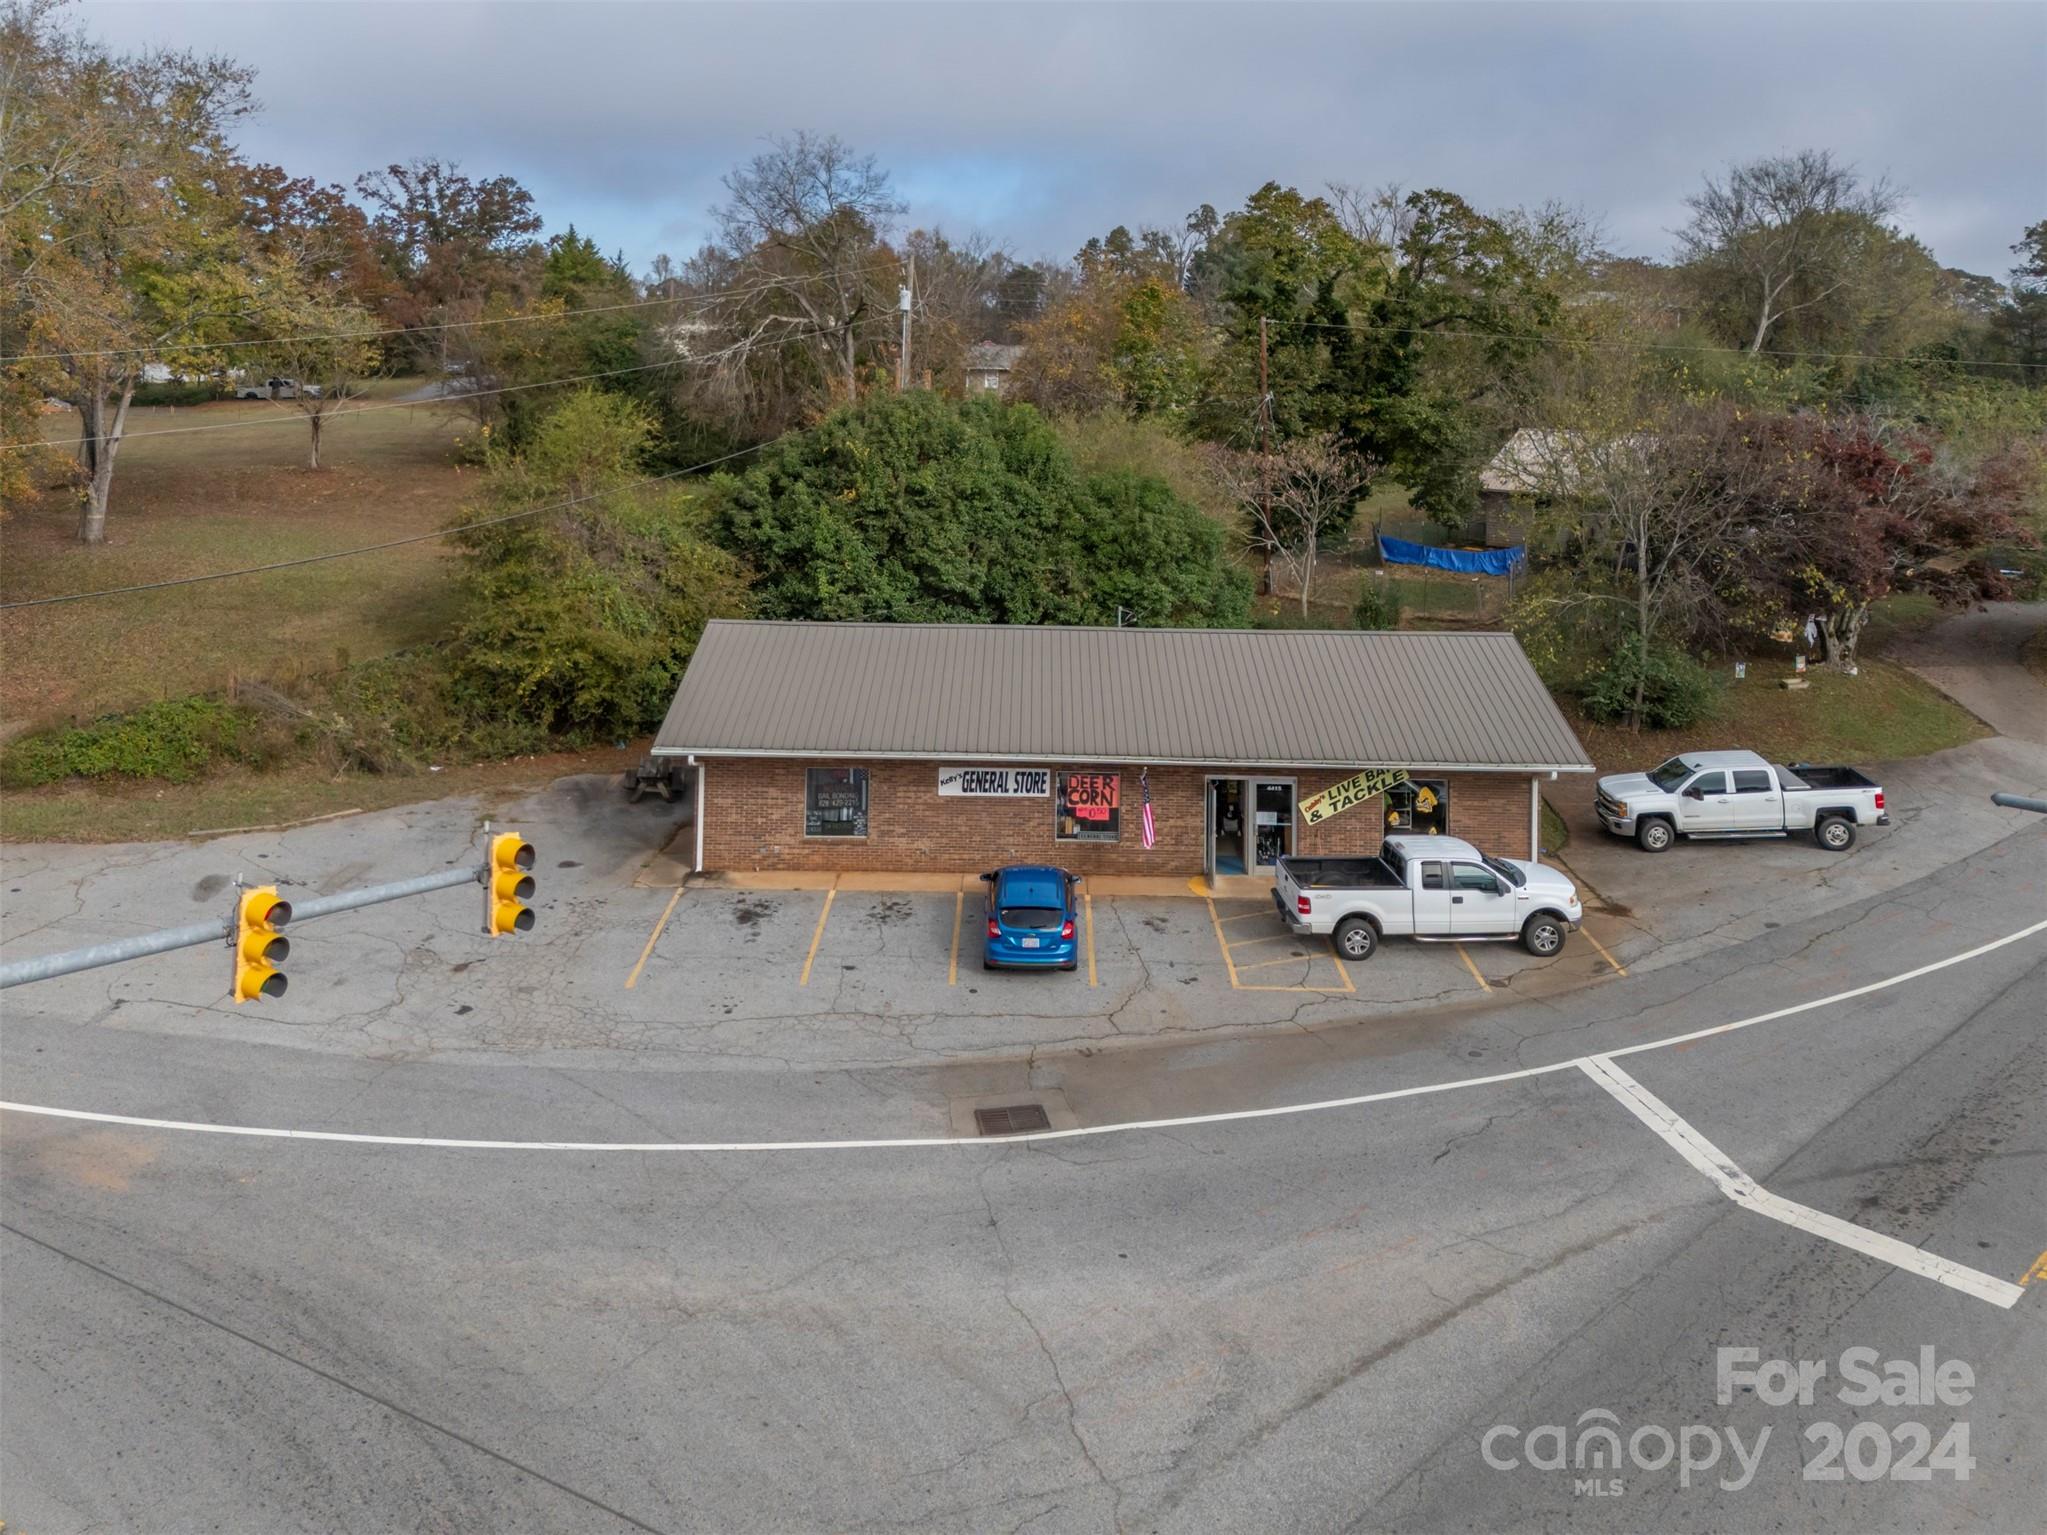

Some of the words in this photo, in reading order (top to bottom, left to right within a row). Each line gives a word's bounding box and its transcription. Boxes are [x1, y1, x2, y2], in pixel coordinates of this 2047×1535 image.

[941, 773, 962, 786] Kelly's
[962, 771, 1009, 793] GENERAL
[1013, 771, 1048, 794] STORE
[1069, 775, 1116, 791] DEER
[1327, 776, 1362, 801] LIVE
[1364, 768, 1391, 783] BA
[1068, 789, 1113, 806] CORN
[1309, 810, 1323, 823] &
[1328, 770, 1405, 813] TACKLE
